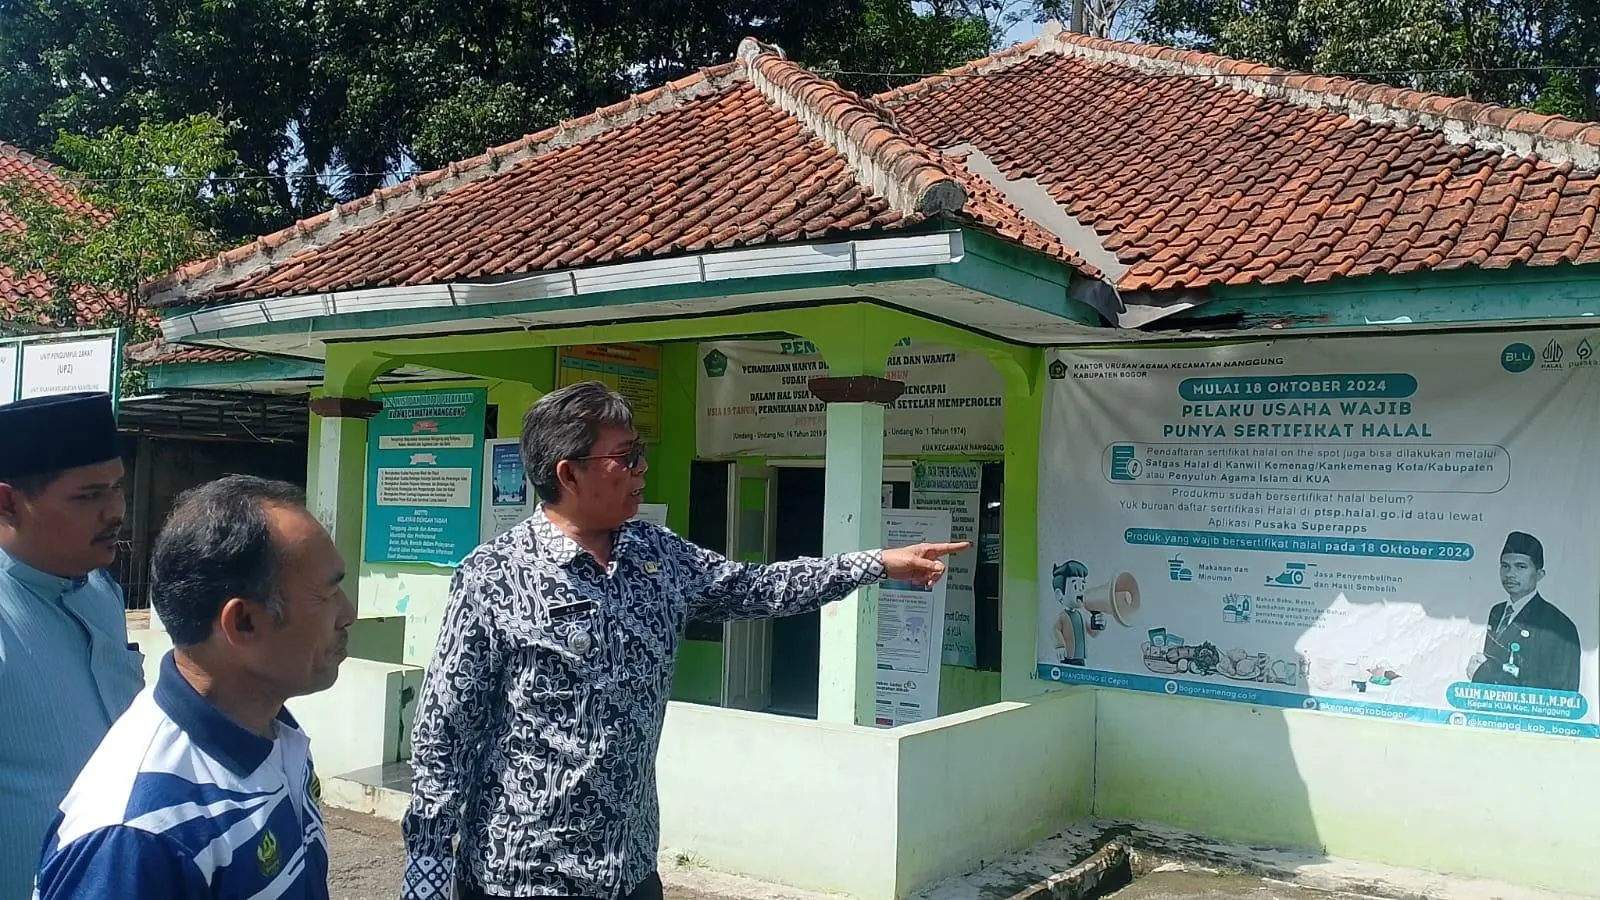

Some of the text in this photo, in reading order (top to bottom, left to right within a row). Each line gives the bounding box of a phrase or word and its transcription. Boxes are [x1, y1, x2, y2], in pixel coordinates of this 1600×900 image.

[742, 362, 791, 374] PERNIKAHAN
[792, 361, 817, 372] HANYA
[903, 356, 921, 365] DAN
[923, 353, 956, 363] WANITA
[1105, 362, 1138, 370] URUSAN
[1224, 357, 1284, 368] NANGGUNG
[782, 375, 807, 385] SUDAH
[1073, 371, 1118, 379] KABUPATEN
[1193, 380, 1387, 395] MULAI 18 OKTOBER 2024
[750, 391, 776, 402] DALAM
[777, 391, 792, 400] HAL
[793, 390, 809, 400] USIA
[707, 408, 722, 416] USIA
[758, 404, 808, 414] PERNIKAHAN
[898, 398, 936, 409] SETELAH
[938, 396, 1002, 408] MEMPEROLEH
[1182, 402, 1412, 417] PELAKU USAHA WAJIB
[794, 430, 809, 438] Tahun
[892, 428, 914, 437] Undang
[930, 426, 950, 435] Tahun
[950, 426, 967, 436] 1974)
[1164, 423, 1432, 438] PUNYA SERTIFIKAT HALAL
[934, 444, 968, 452] KECAMATAN
[970, 443, 1004, 452] NANGGUNG
[1146, 447, 1204, 456] Pendaftaran
[1208, 448, 1250, 456] sertifikat
[1253, 448, 1278, 457] halal
[1297, 449, 1314, 458] the
[1317, 450, 1340, 460] spot
[1343, 450, 1366, 460] juga
[1370, 450, 1392, 458] bisa
[1396, 450, 1450, 458] dilakukan
[1456, 450, 1497, 458] melalui
[1145, 458, 1494, 472] Satgas Halal di Kanwil Kemenag/Kankemenag Kota/Kabupaten
[1146, 471, 1331, 484] atau Penyuluh Agama Islam di KUA
[1172, 488, 1414, 504] Produkmu sudah bersertifikat halal belum?
[1120, 500, 1484, 522] Yuk buruan daftar sertifikasi Halal di ptsp.halal.go.id atau lewat
[1208, 518, 1368, 534] Aplikasi Pusaka Superapps
[1126, 532, 1470, 557] Produk yang wajib bersertifikat halal pada 18 Oktober 2024
[1198, 564, 1232, 573] Makanan
[1198, 573, 1233, 582] Minuman
[1336, 572, 1403, 584] Penyembelihan
[1314, 581, 1397, 592] dan Hasil Sembelih
[1454, 686, 1480, 700] SALIM
[1467, 700, 1492, 709] Kepala
[1494, 702, 1512, 711] KUA
[1532, 706, 1570, 717] Nanggung
